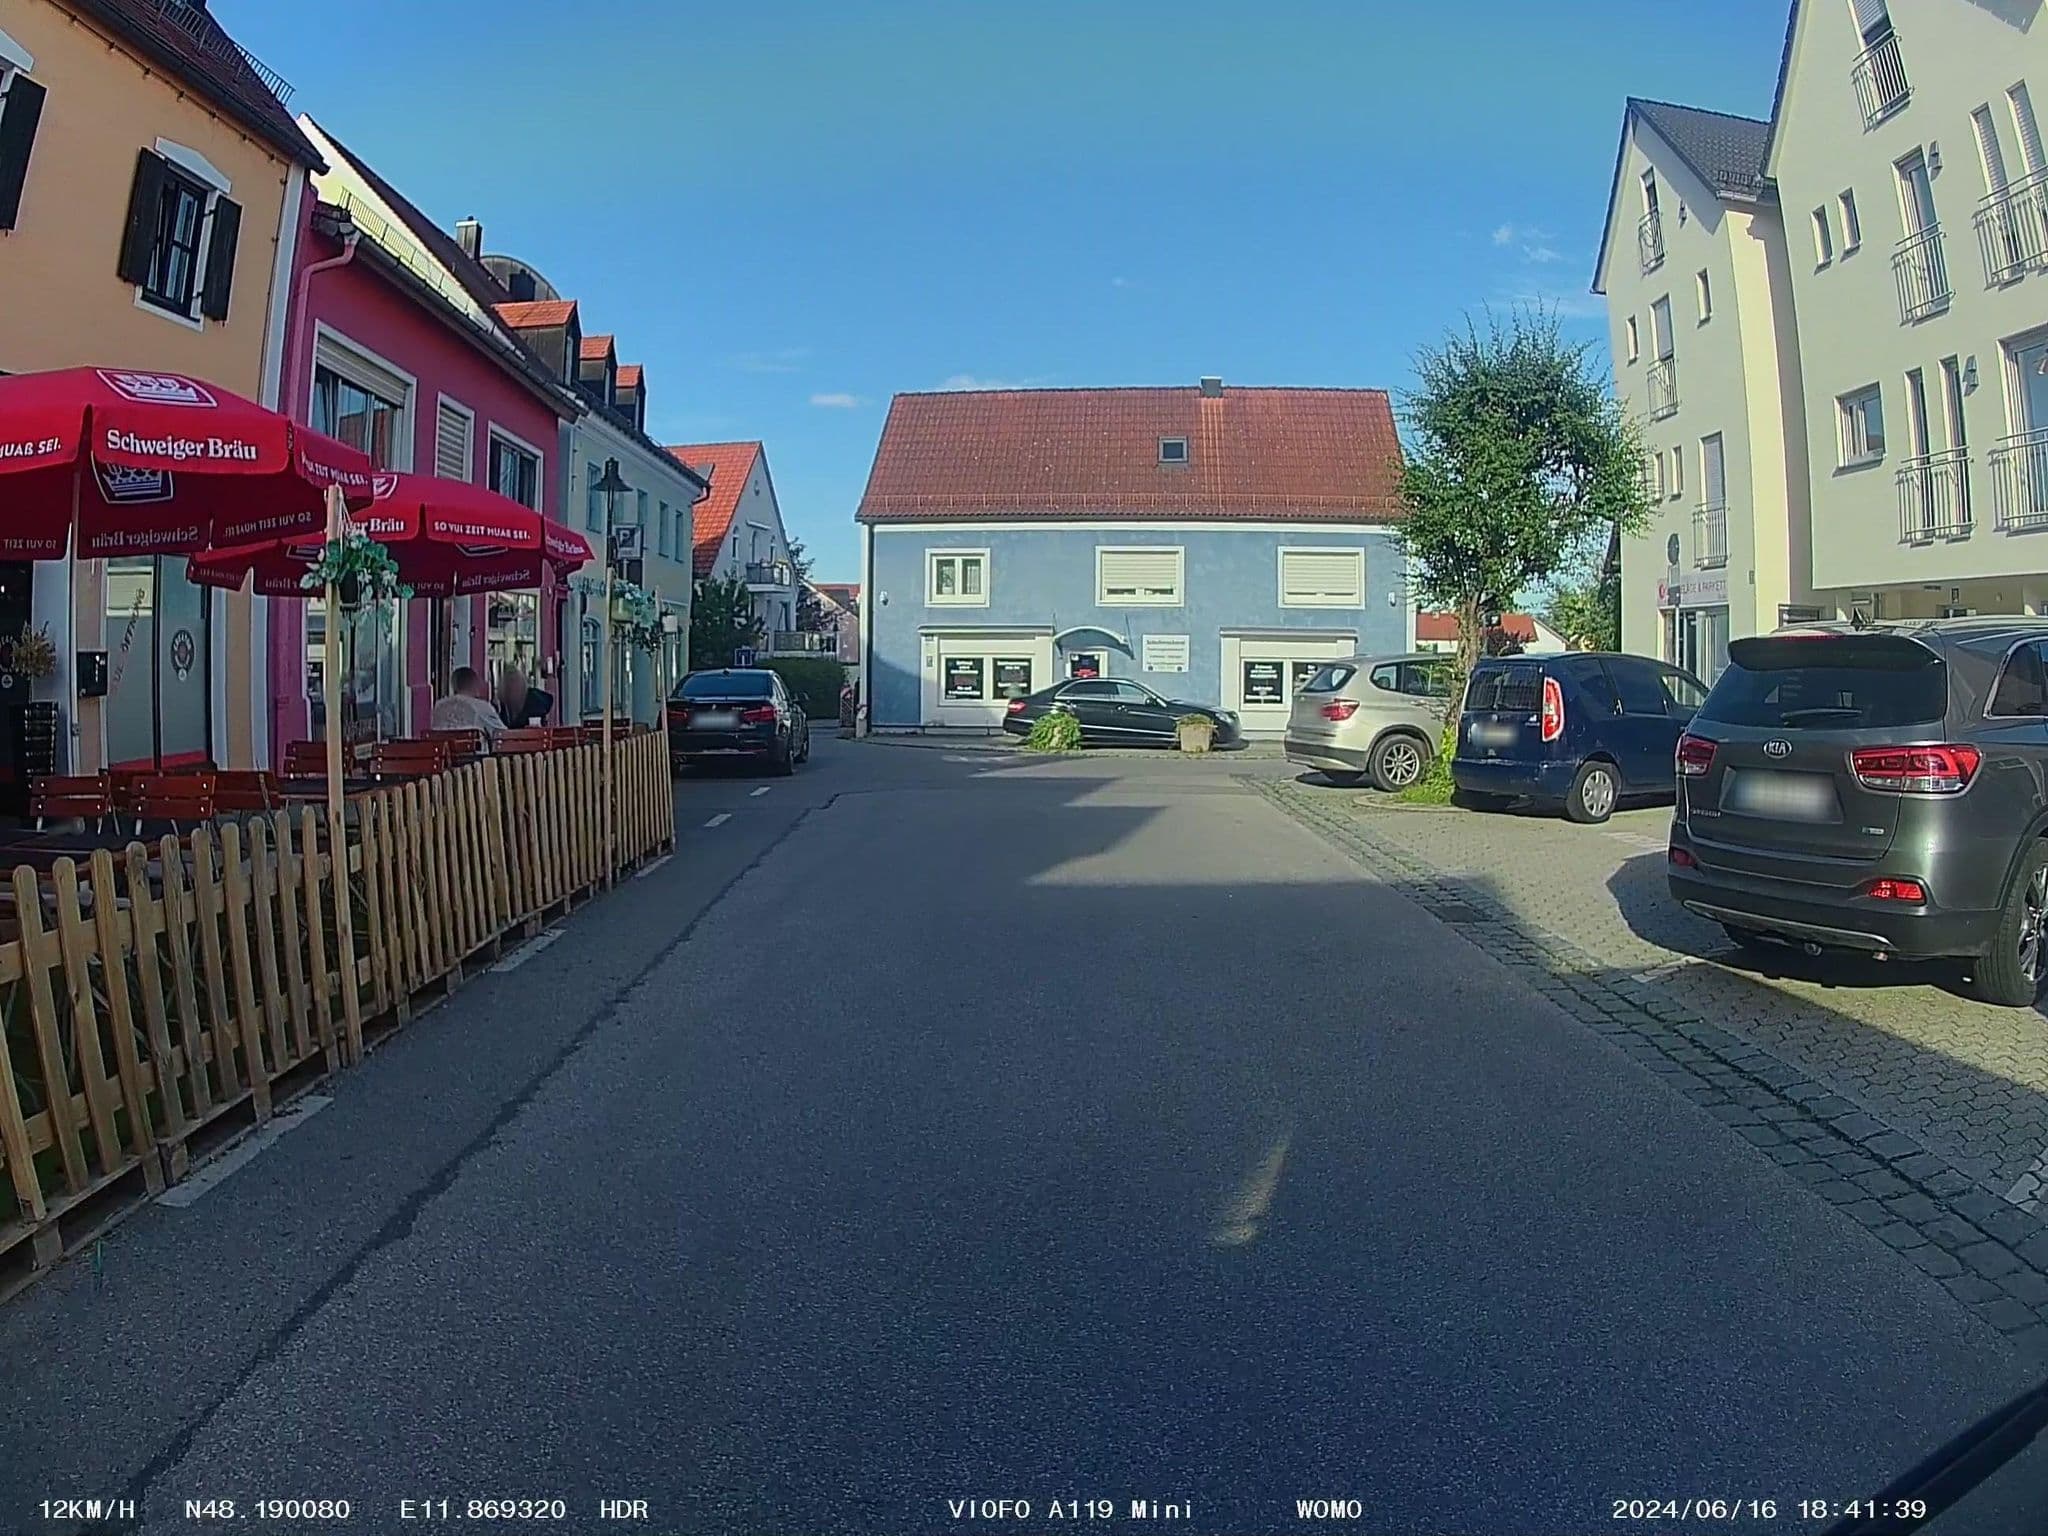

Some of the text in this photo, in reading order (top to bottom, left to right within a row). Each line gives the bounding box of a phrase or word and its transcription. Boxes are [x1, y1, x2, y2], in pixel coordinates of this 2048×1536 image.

[37, 437, 62, 455] SEI.
[107, 429, 257, 461] Schweiger Bräu
[369, 518, 405, 532] Bräu
[433, 521, 447, 531] SO
[448, 523, 463, 534] VUI
[465, 525, 485, 536] ZEIT
[1768, 742, 1786, 755] KIA
